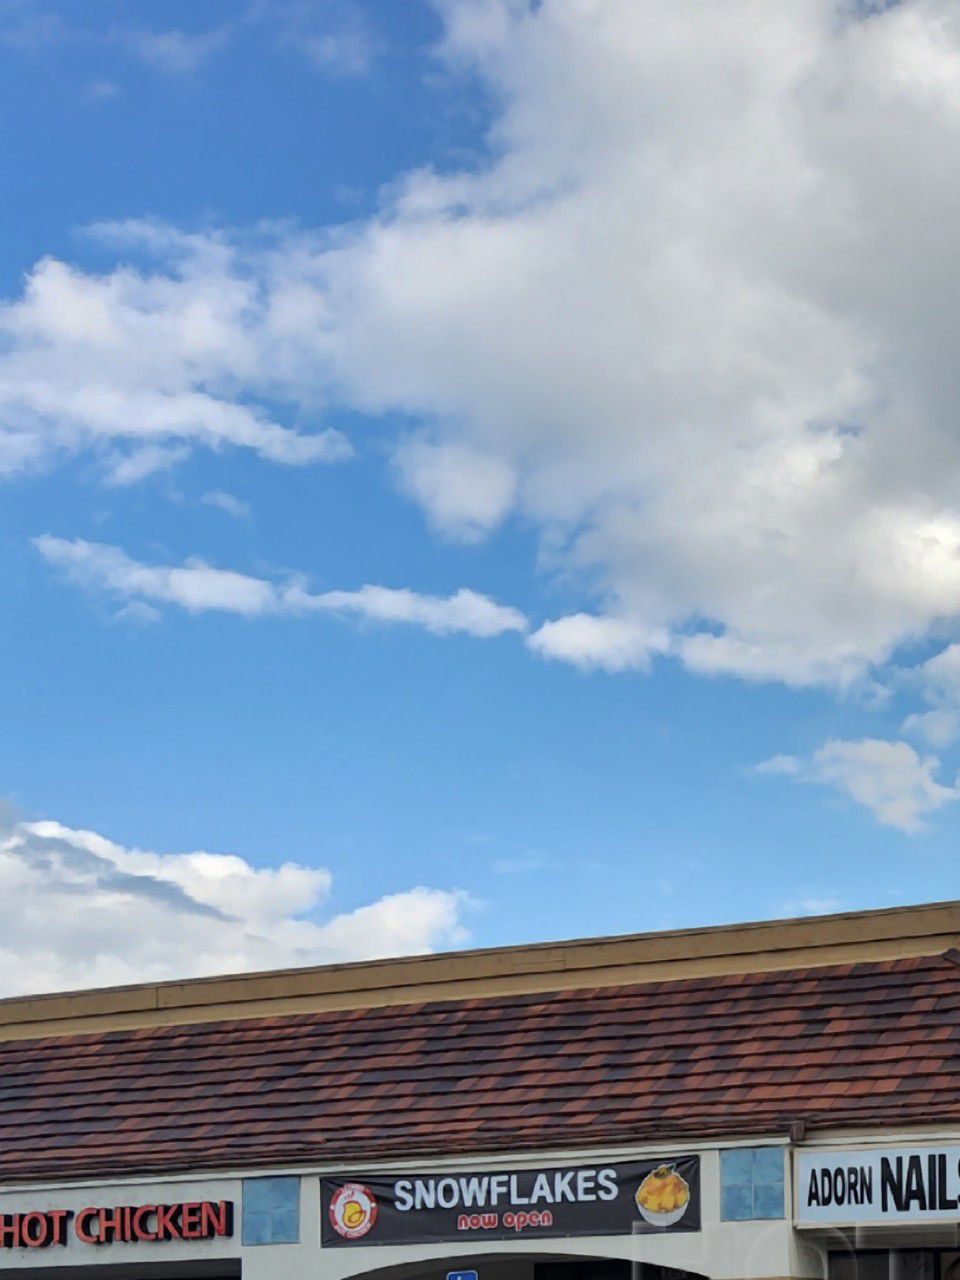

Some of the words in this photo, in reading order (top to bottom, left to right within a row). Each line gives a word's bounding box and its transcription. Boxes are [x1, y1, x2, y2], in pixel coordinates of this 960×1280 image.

[394, 1168, 619, 1212] SNOWFLAKES
[807, 1166, 873, 1207] ADORN
[0, 1209, 72, 1249] HOT
[75, 1199, 233, 1246] CHICKEN
[457, 1213, 499, 1231] now
[502, 1210, 553, 1232] open
